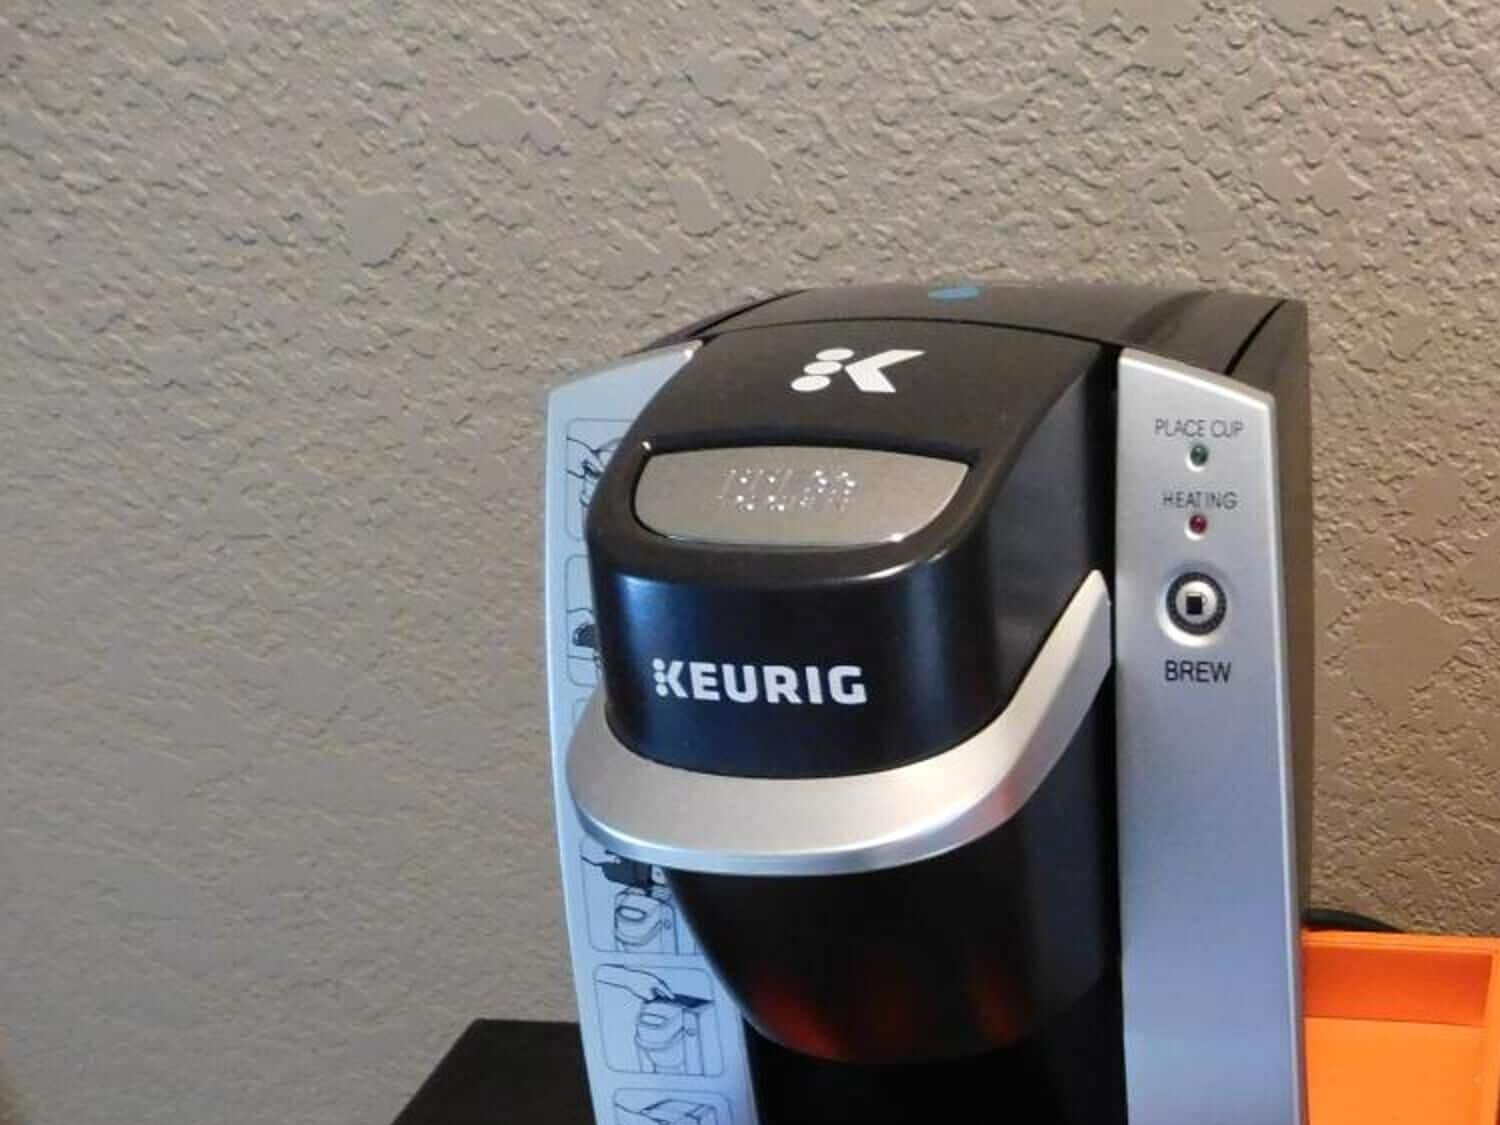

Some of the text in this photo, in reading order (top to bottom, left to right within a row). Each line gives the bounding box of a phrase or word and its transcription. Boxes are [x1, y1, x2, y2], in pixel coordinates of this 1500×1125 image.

[1154, 418, 1245, 438] PLACE CUP
[1162, 490, 1239, 511] HEATING
[652, 658, 868, 705] KEURIG
[1164, 659, 1232, 683] BREW
